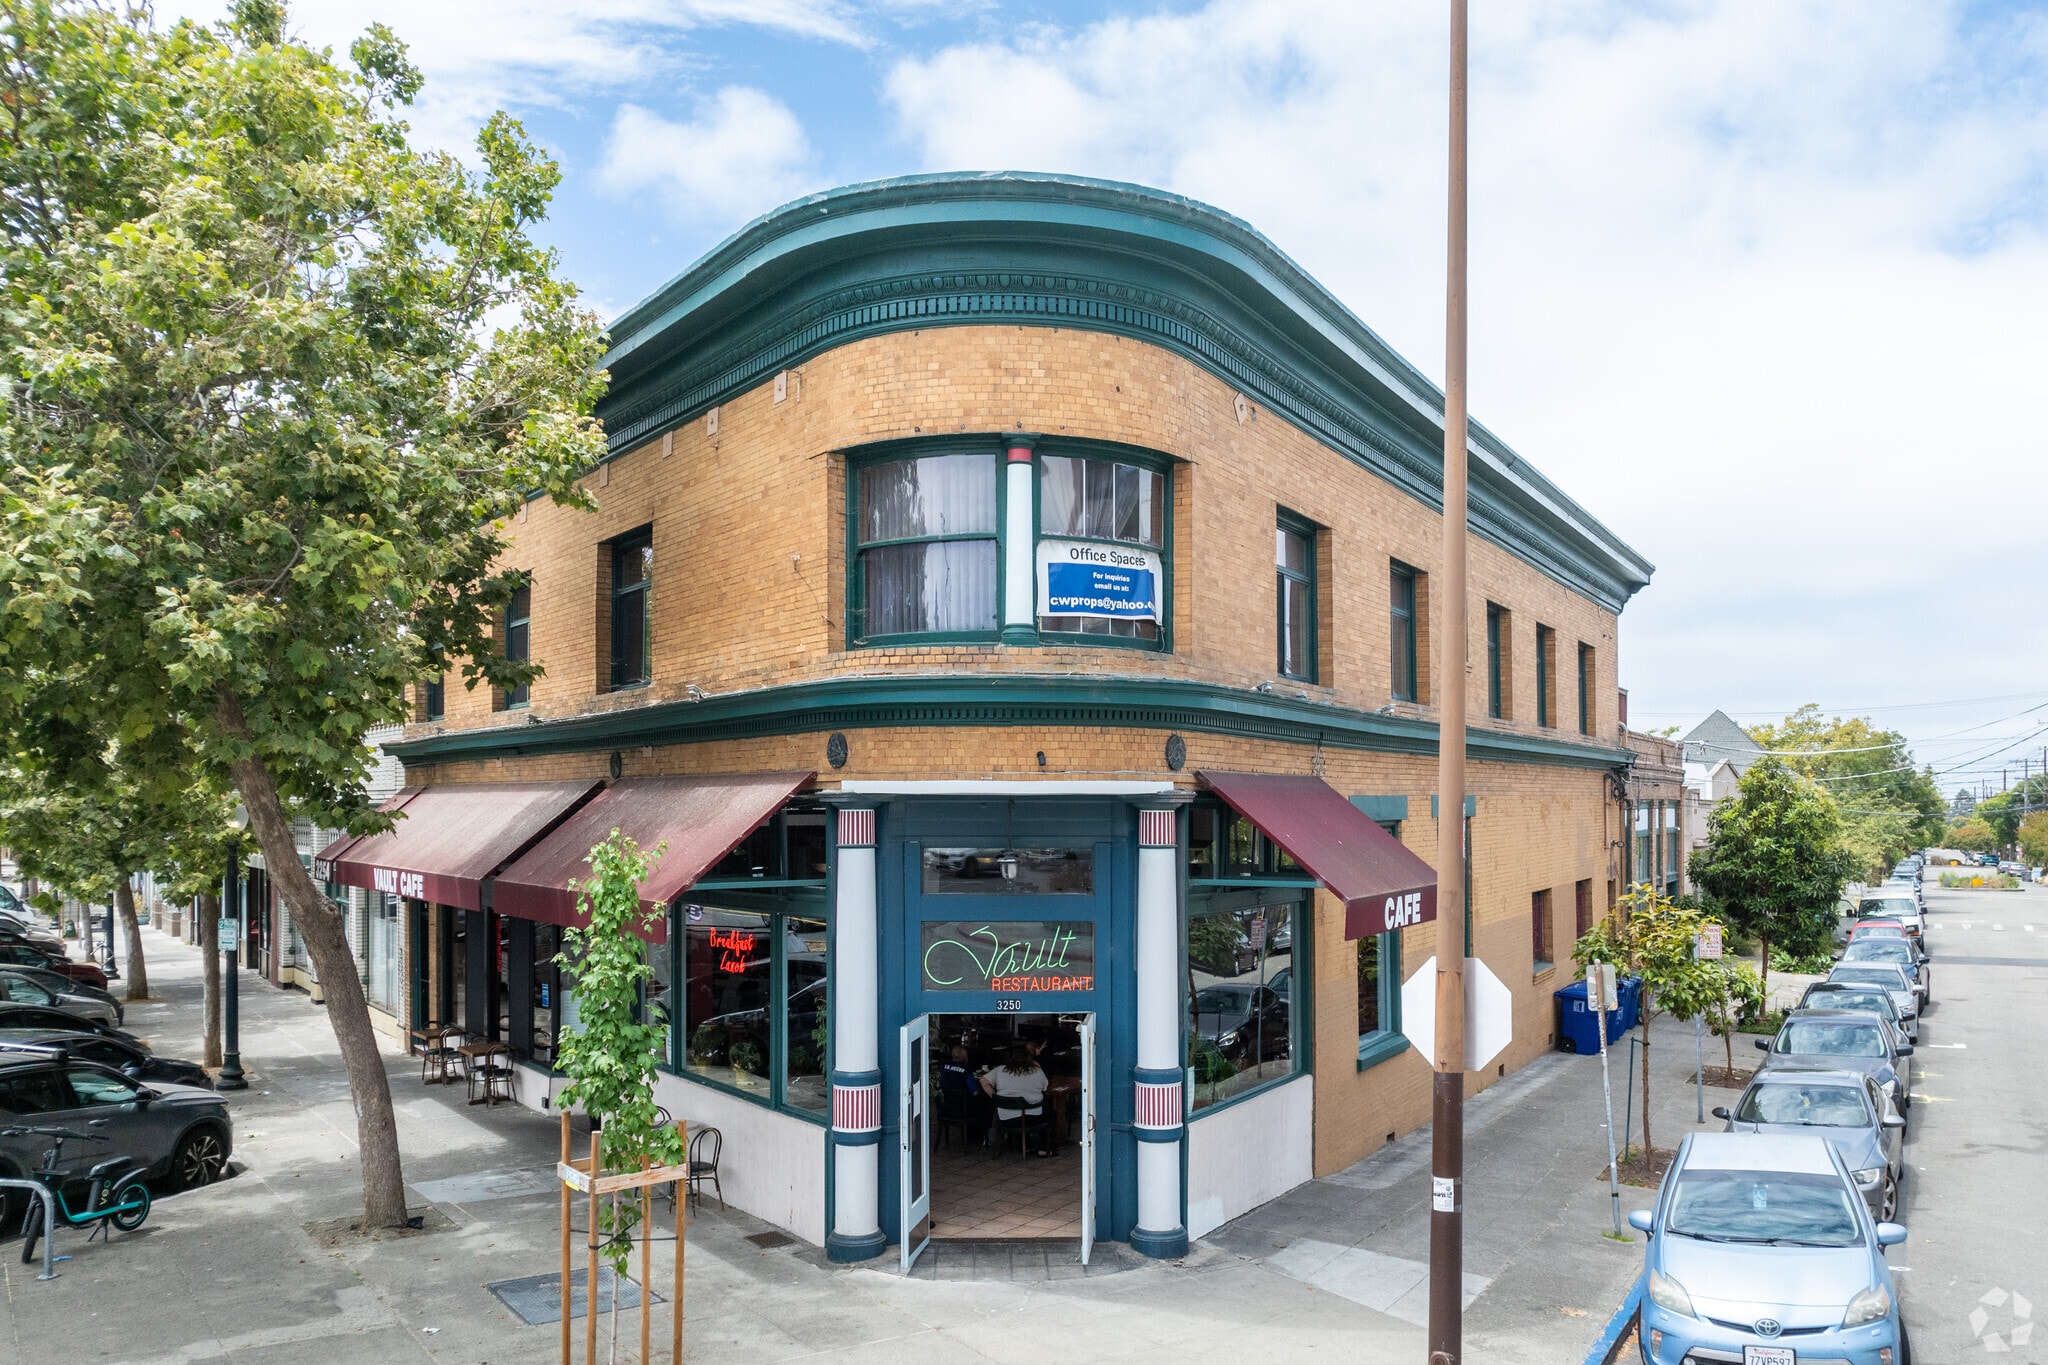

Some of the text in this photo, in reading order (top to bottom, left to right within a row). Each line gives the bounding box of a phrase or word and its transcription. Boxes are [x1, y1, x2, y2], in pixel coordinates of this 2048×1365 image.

[1069, 547, 1146, 567] Office Spaces
[1093, 571, 1104, 579] For
[373, 867, 424, 899] VAULT CAFE
[1384, 892, 1421, 930] CAFE
[709, 927, 755, 957] Breakfast
[720, 950, 746, 974] Lunch
[924, 925, 1077, 985] Vault
[991, 975, 1092, 992] RESTAURANT
[996, 999, 1021, 1011] 3250
